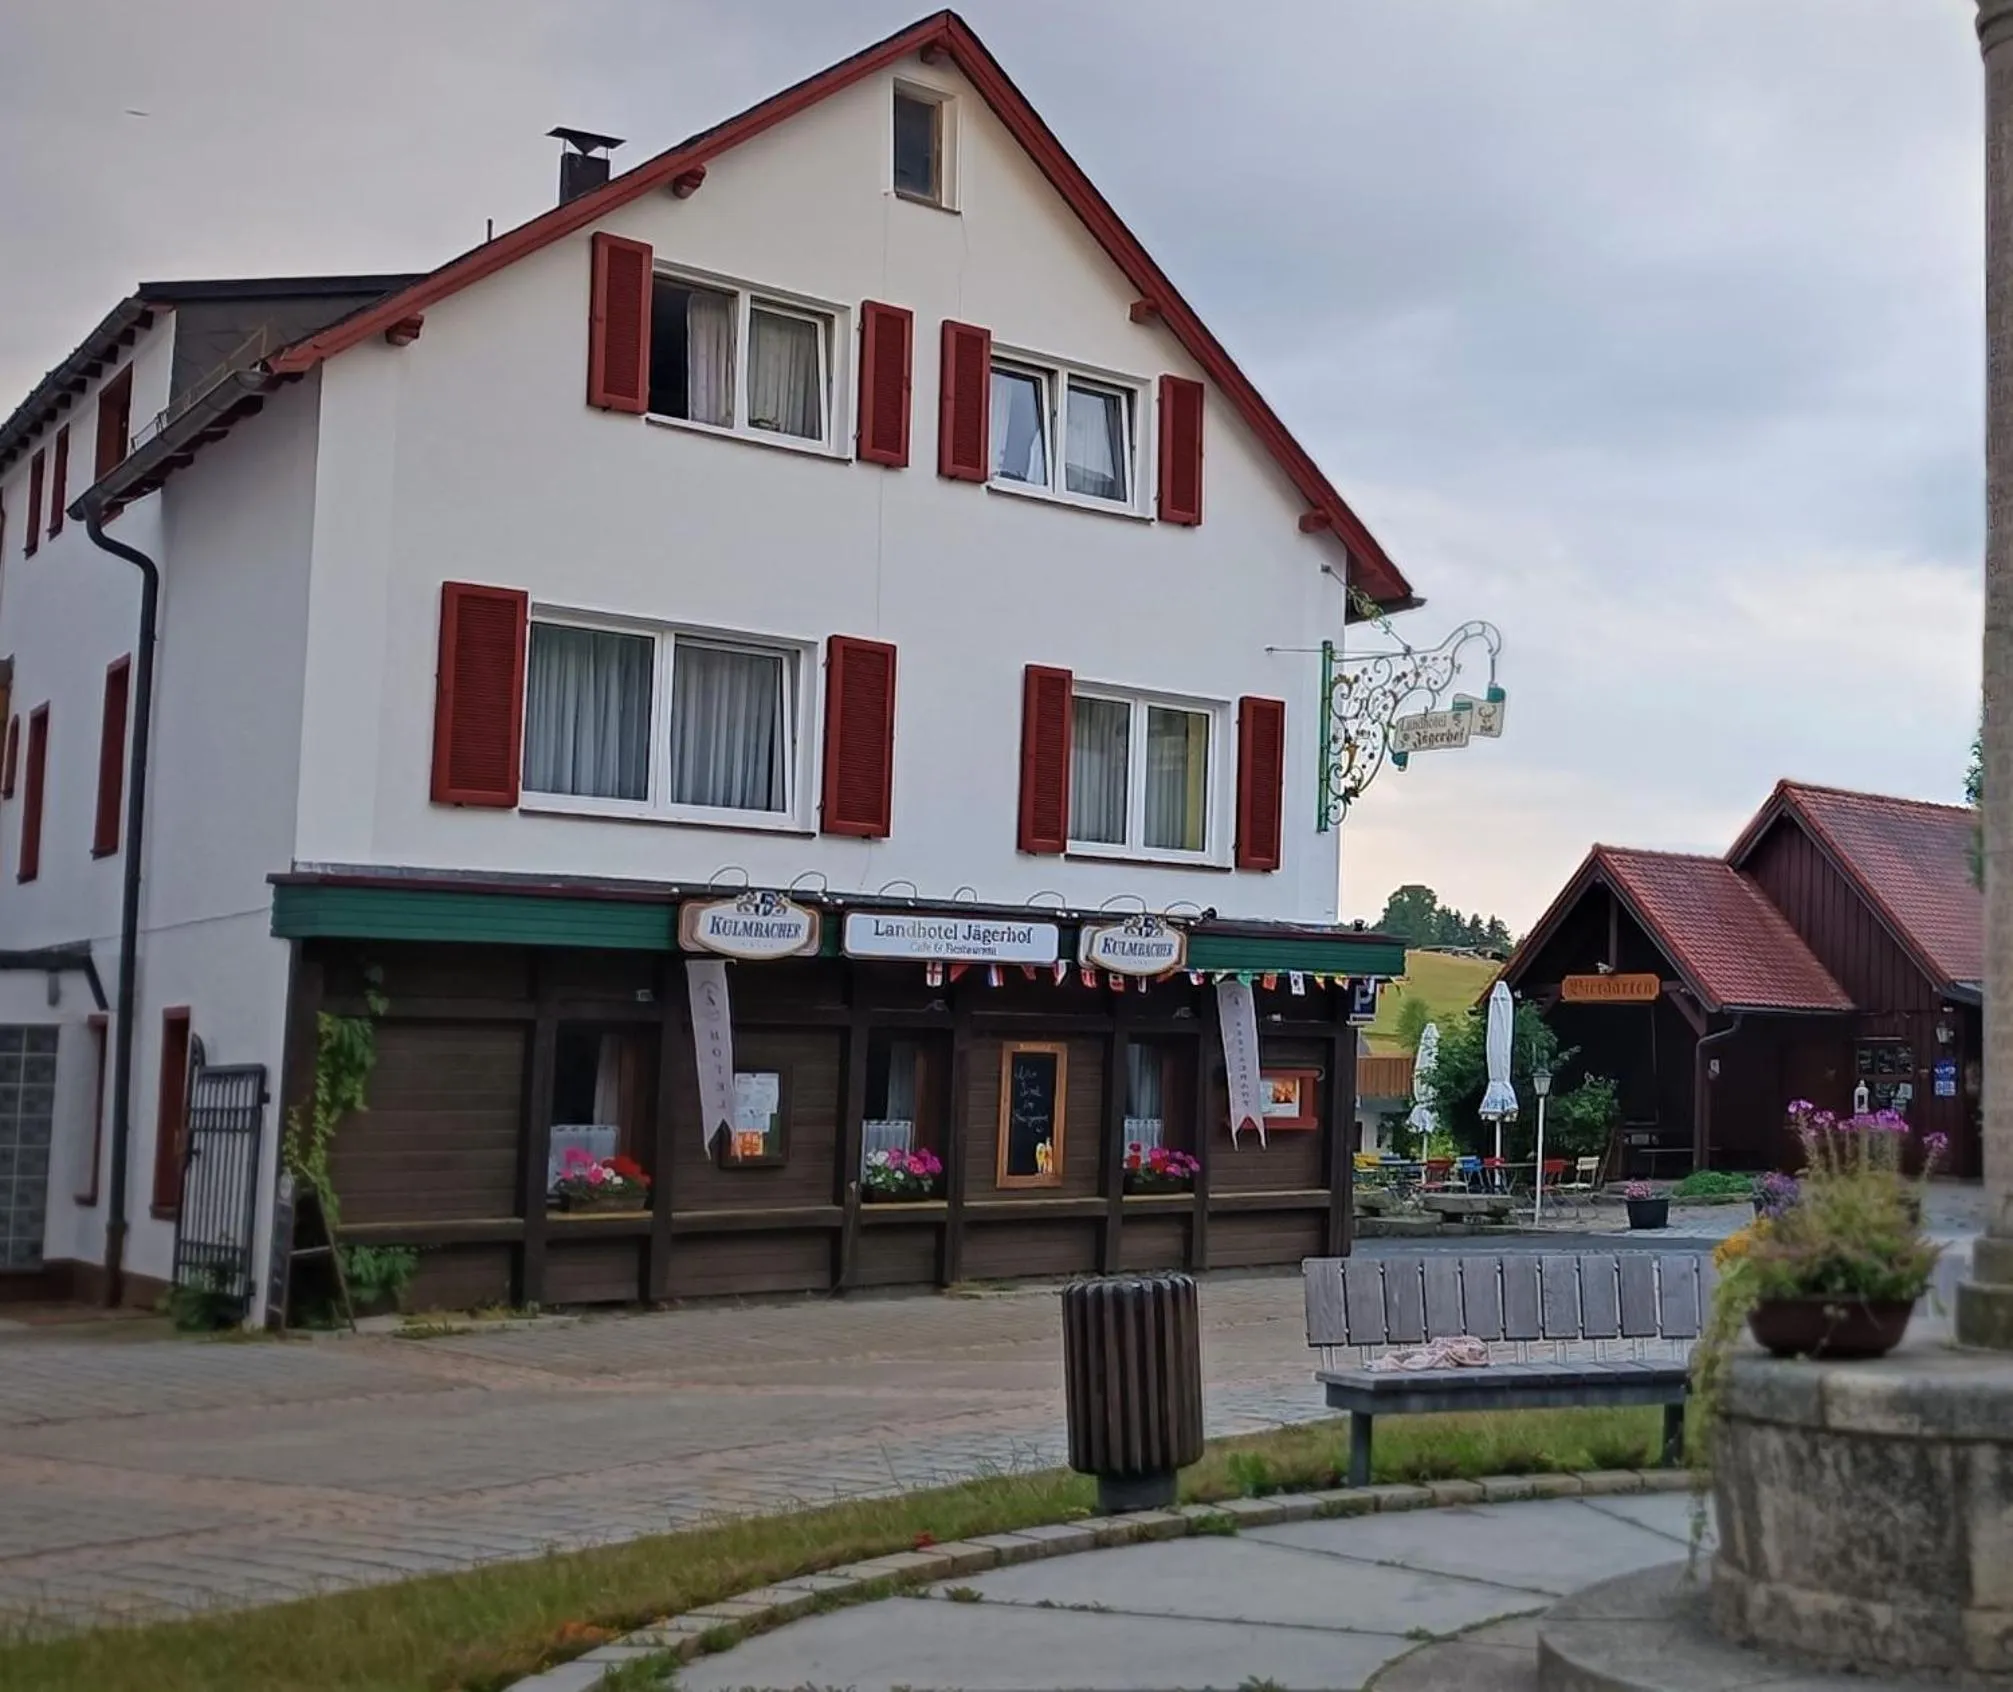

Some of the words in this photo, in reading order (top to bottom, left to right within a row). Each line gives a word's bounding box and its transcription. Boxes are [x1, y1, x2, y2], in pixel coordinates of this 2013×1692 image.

[709, 915, 801, 939] KULMBACHER
[873, 919, 957, 941] Landhotel
[962, 924, 1033, 945] Jägerhof
